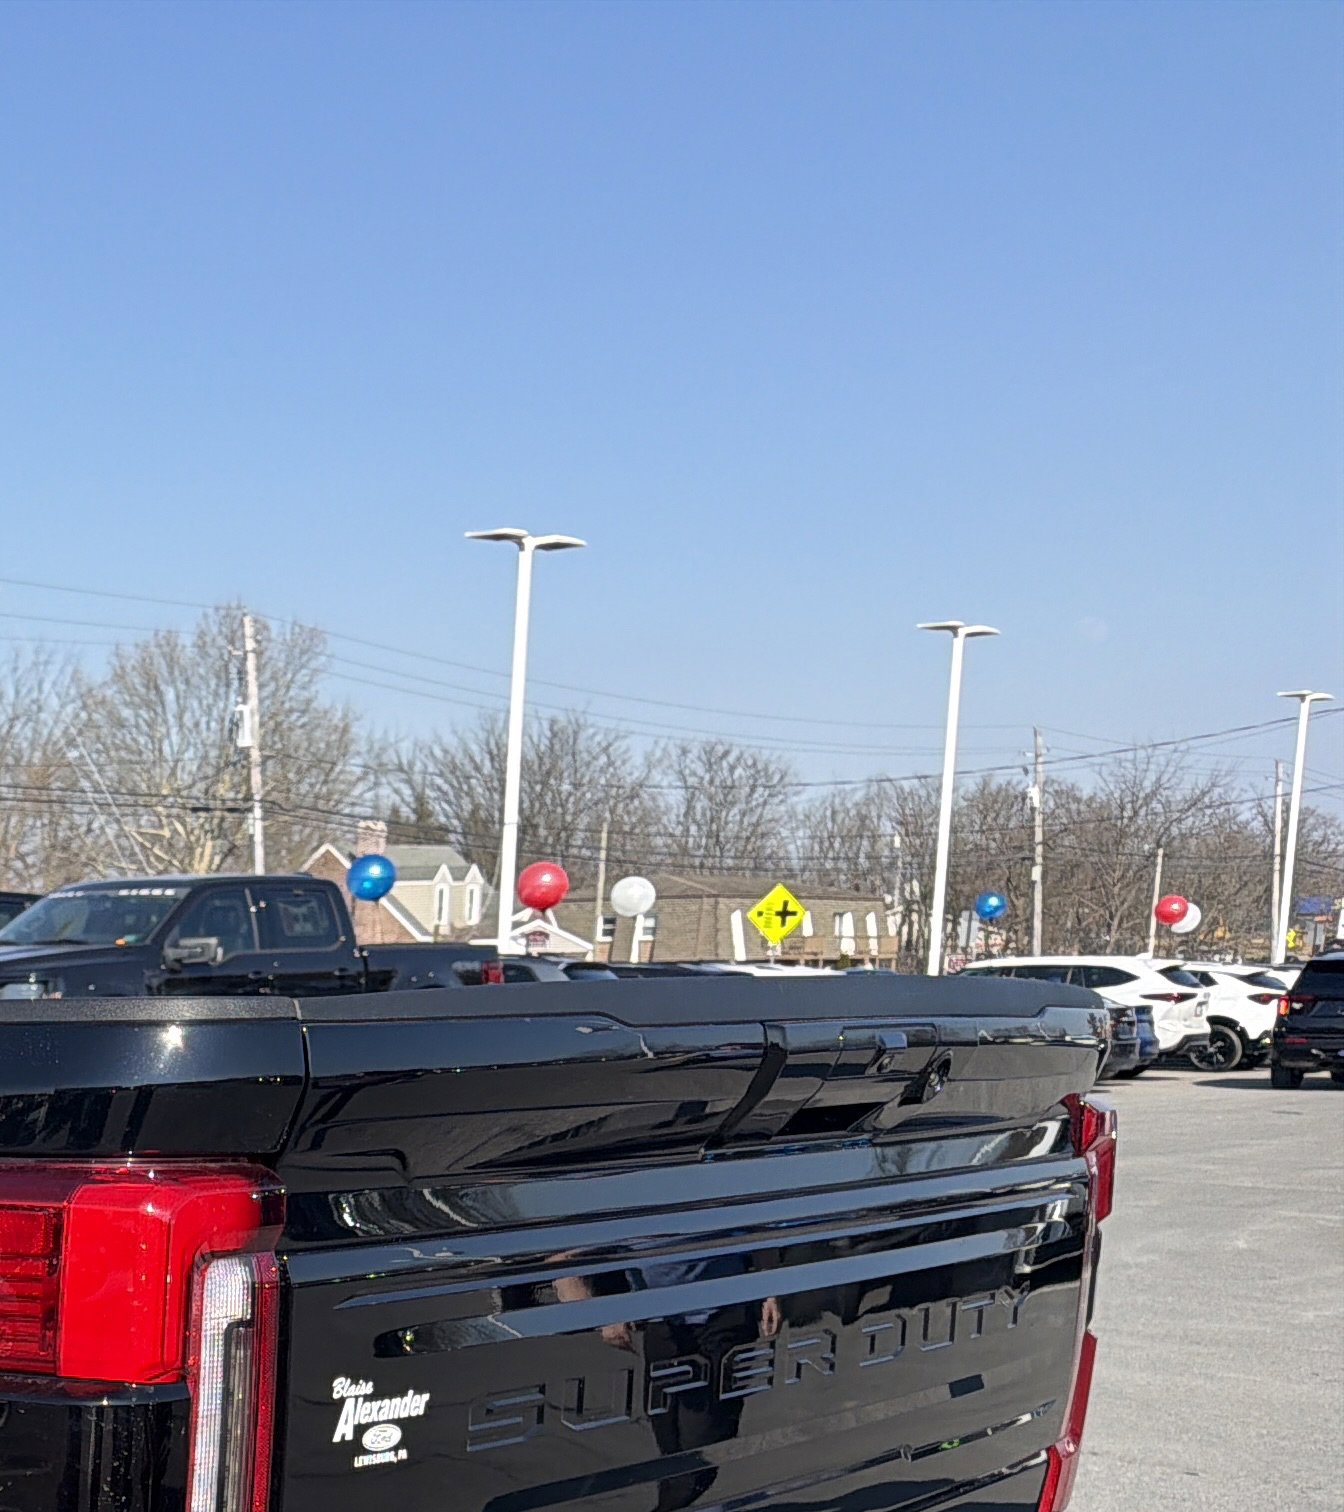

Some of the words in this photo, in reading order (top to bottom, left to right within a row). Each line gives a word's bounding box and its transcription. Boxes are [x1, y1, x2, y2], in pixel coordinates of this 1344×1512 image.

[332, 1377, 374, 1399] Blaise
[466, 1326, 838, 1453] SUPER
[858, 1281, 1030, 1367] DUTY
[332, 1389, 430, 1443] Alexander
